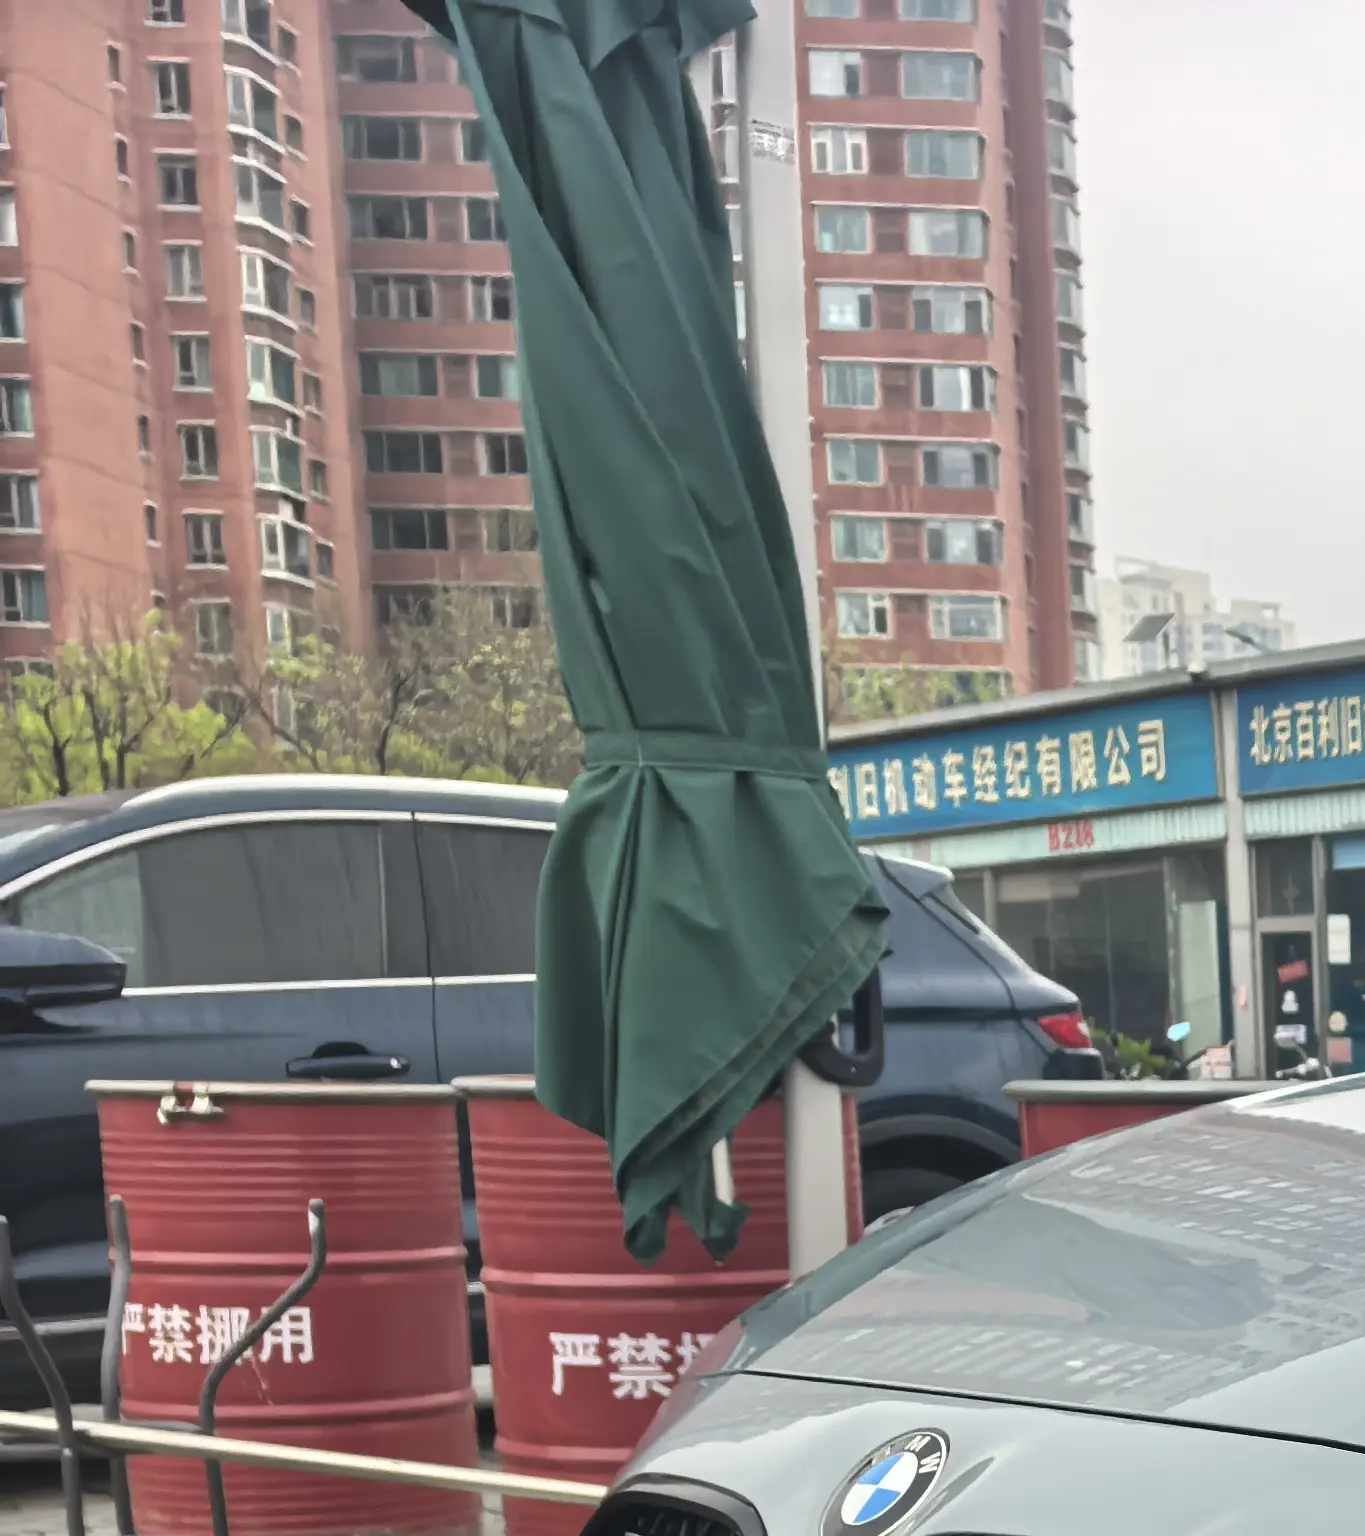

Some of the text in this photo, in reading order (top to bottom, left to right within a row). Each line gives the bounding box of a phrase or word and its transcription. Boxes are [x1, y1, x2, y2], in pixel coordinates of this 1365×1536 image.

[1048, 820, 1096, 852] B218
[121, 1302, 315, 1366] 严禁挪用
